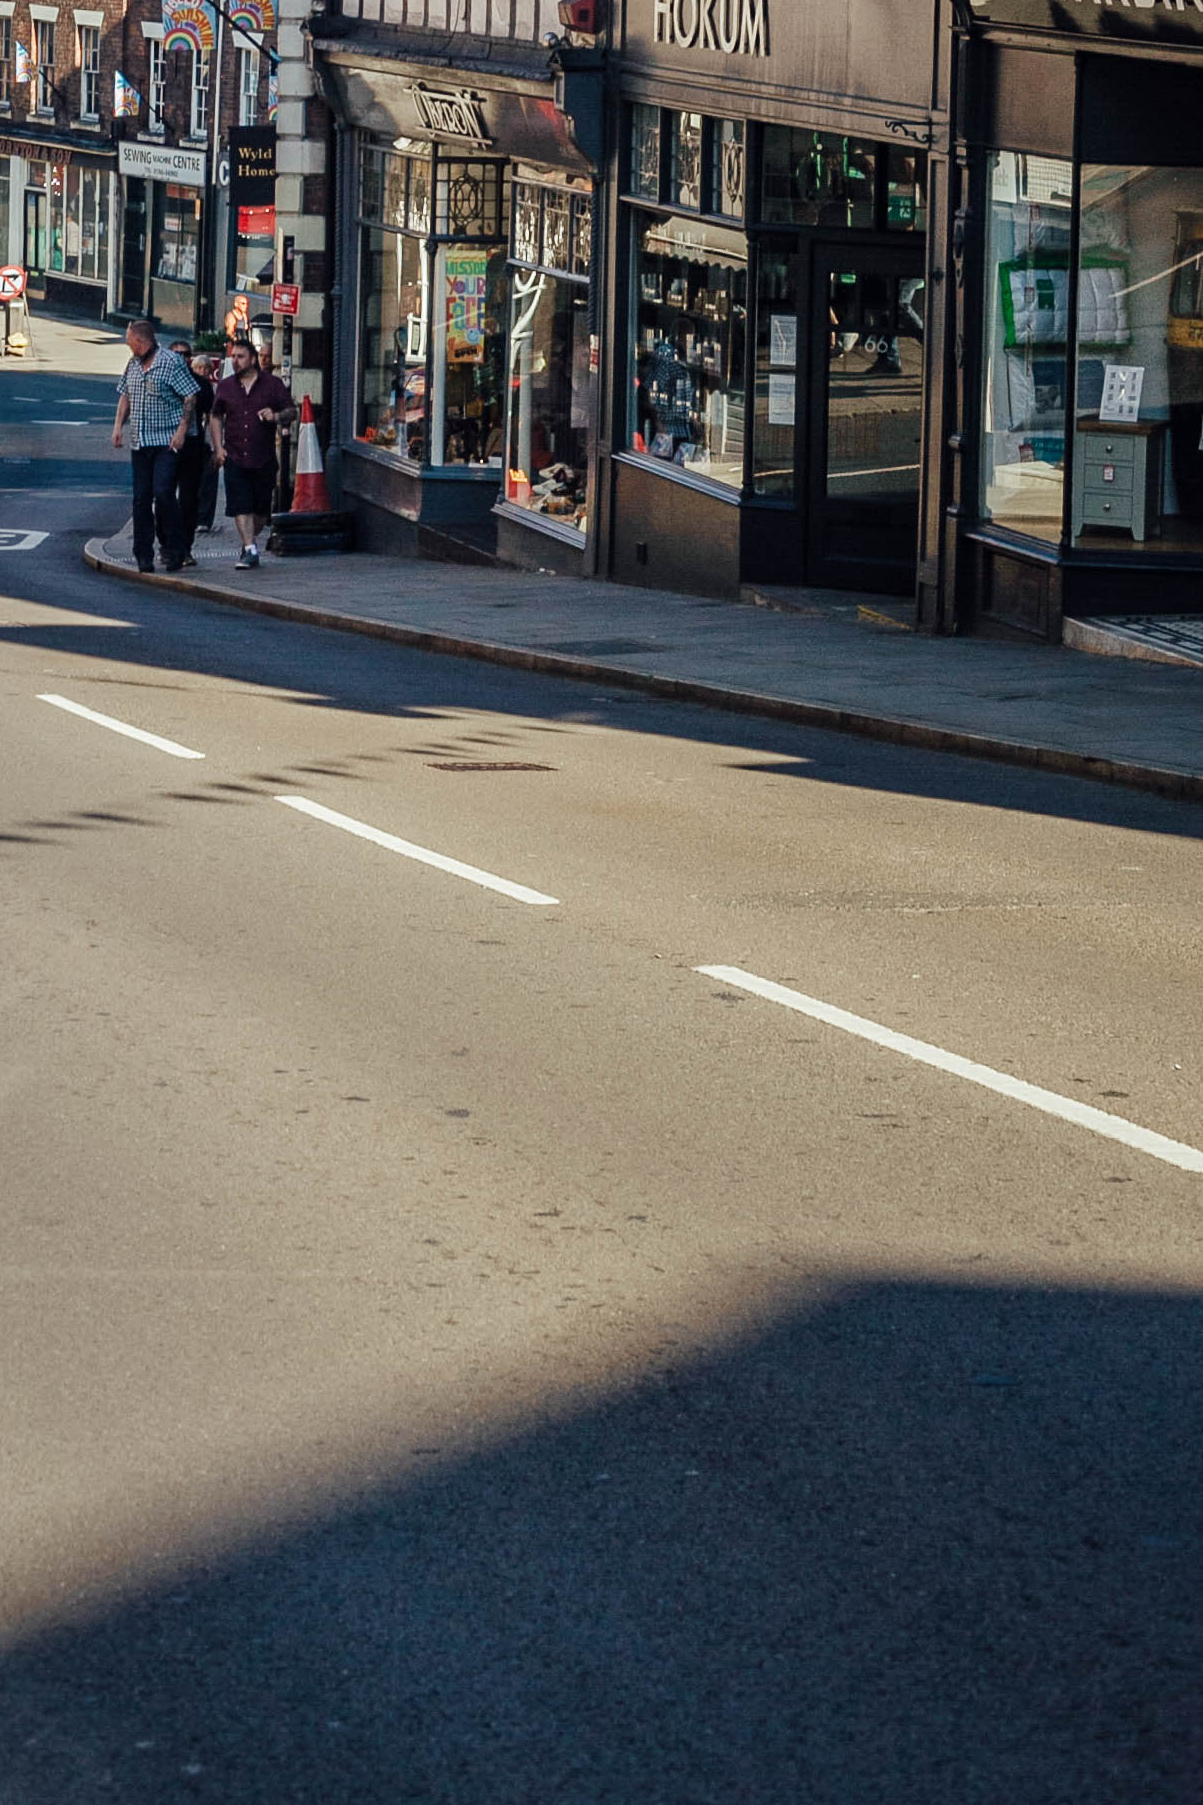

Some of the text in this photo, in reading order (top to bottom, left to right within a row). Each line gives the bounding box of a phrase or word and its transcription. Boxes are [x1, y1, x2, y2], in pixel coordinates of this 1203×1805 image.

[124, 148, 151, 164] SEWING
[173, 155, 200, 171] CENTRE
[238, 147, 273, 162] Wyld
[238, 164, 276, 177] Home
[446, 276, 487, 295] YOUR
[864, 335, 888, 353] 66
